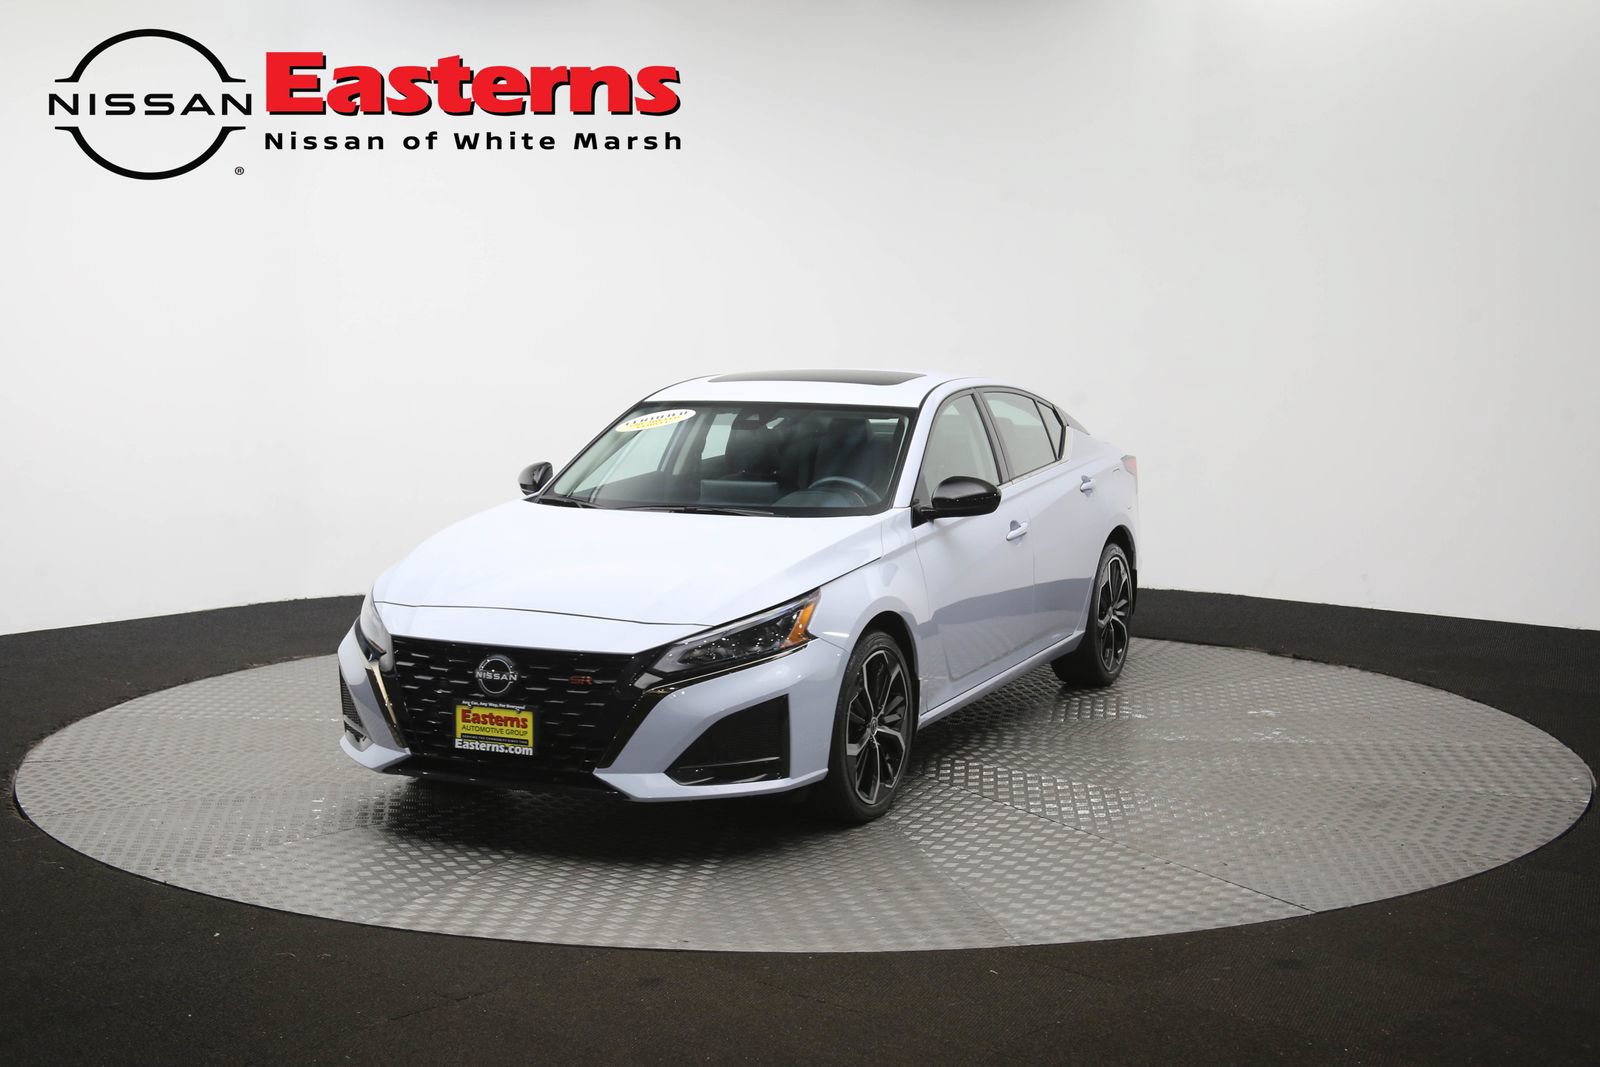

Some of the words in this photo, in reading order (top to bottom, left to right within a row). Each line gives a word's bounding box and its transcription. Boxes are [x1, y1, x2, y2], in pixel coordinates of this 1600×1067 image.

[475, 671, 518, 681] NISSAN
[461, 709, 529, 729] Easterns
[462, 725, 504, 735] AUTOMOTIVE
[505, 728, 528, 737] GROUP
[454, 738, 534, 756] Easterns.com
